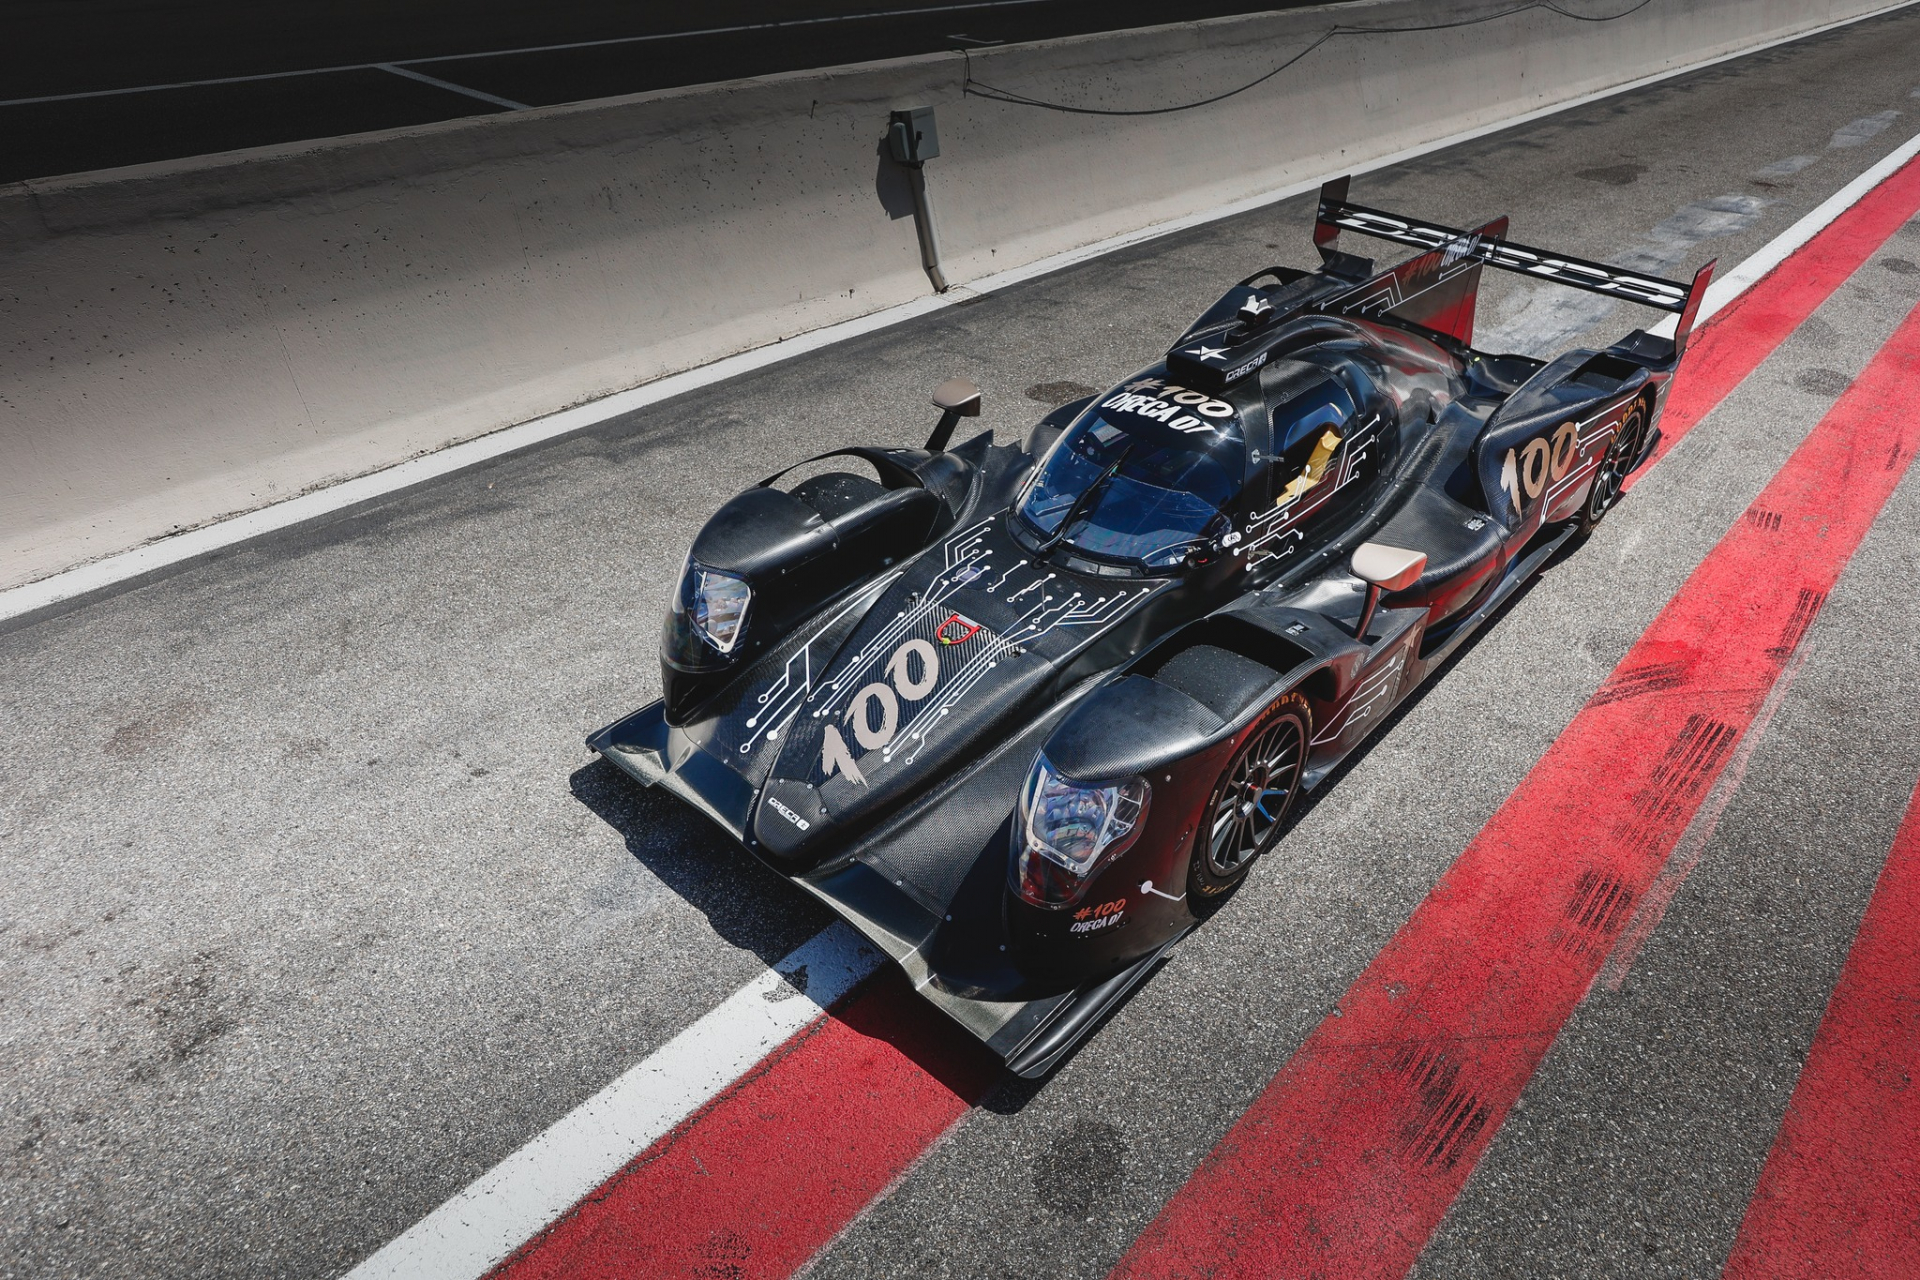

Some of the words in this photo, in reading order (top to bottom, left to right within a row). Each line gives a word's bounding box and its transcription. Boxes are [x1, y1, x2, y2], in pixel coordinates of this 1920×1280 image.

[1225, 357, 1260, 384] ORECA
[1101, 392, 1182, 423] ORECA
[1168, 415, 1216, 434] 07
[1124, 377, 1234, 417] #100
[1501, 421, 1578, 522] 100
[822, 639, 939, 789] 100
[767, 797, 801, 824] ORECA
[1070, 916, 1108, 933] ORECA
[1108, 910, 1124, 926] 07
[1072, 898, 1127, 921] #100
